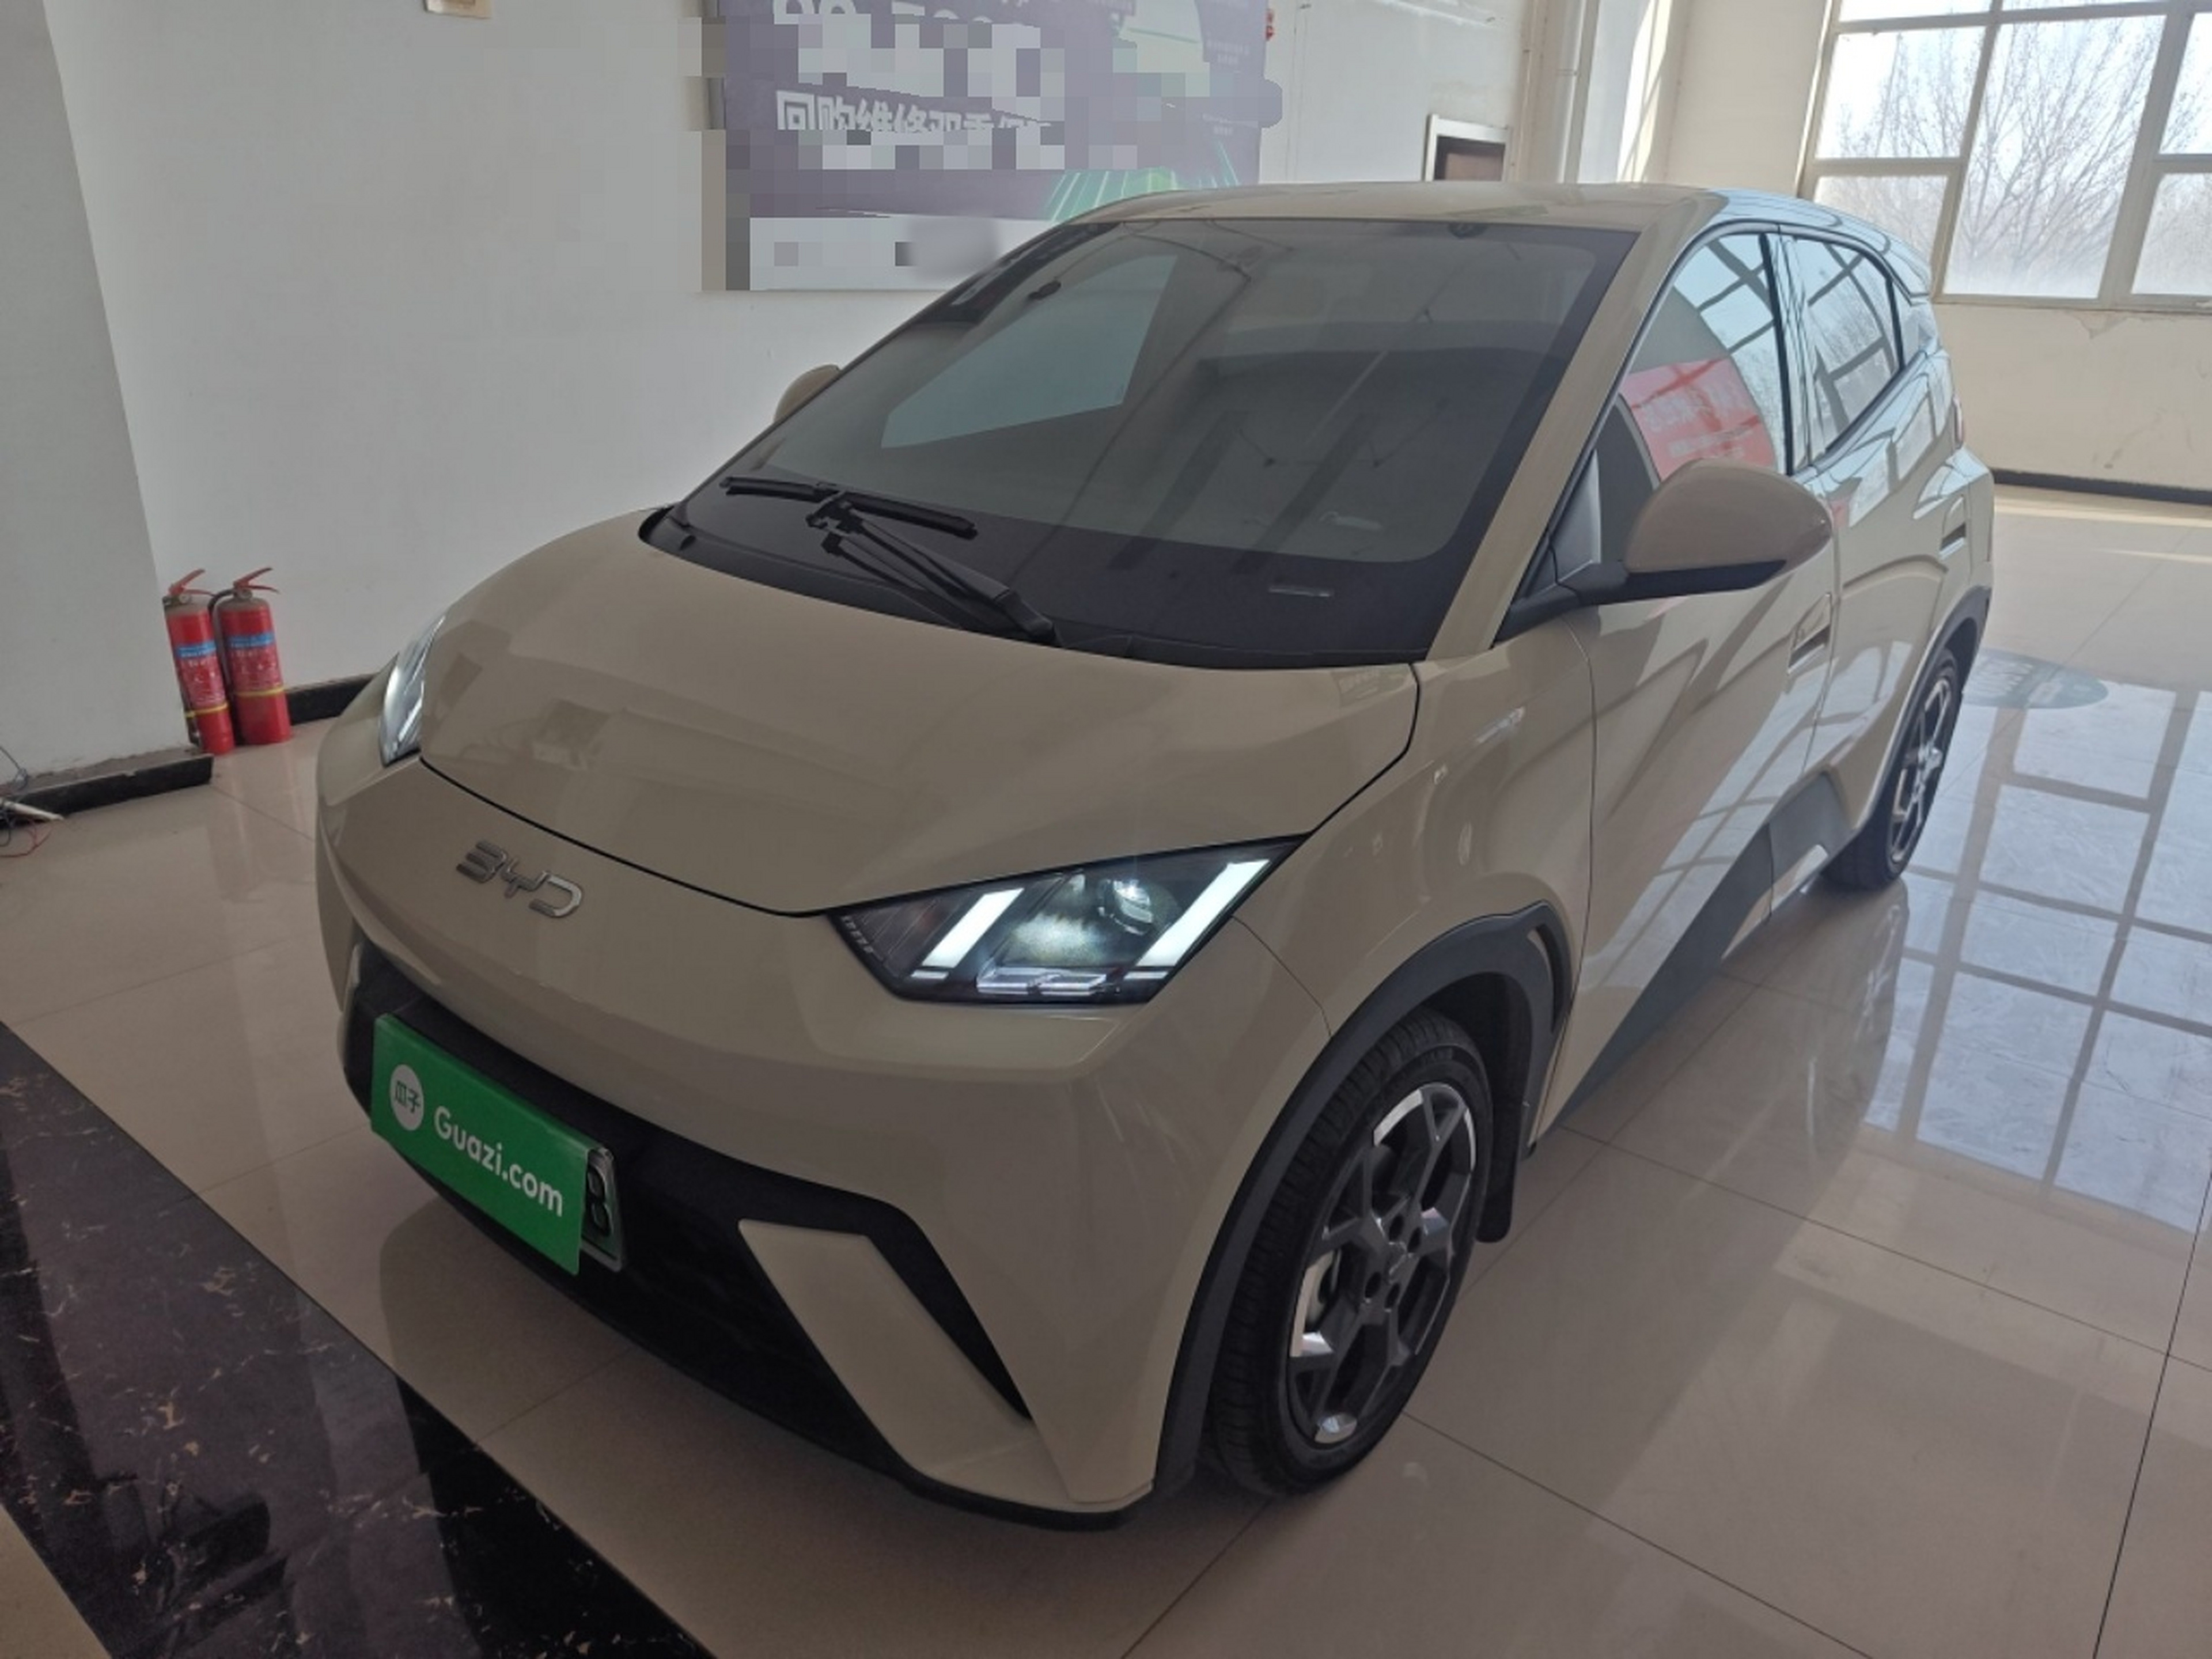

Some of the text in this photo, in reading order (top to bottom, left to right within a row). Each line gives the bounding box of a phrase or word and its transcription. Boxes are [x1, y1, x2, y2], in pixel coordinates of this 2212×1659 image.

[456, 840, 582, 918] BYD
[395, 1080, 421, 1114] 瓜子
[434, 1105, 563, 1218] Guazi.com
